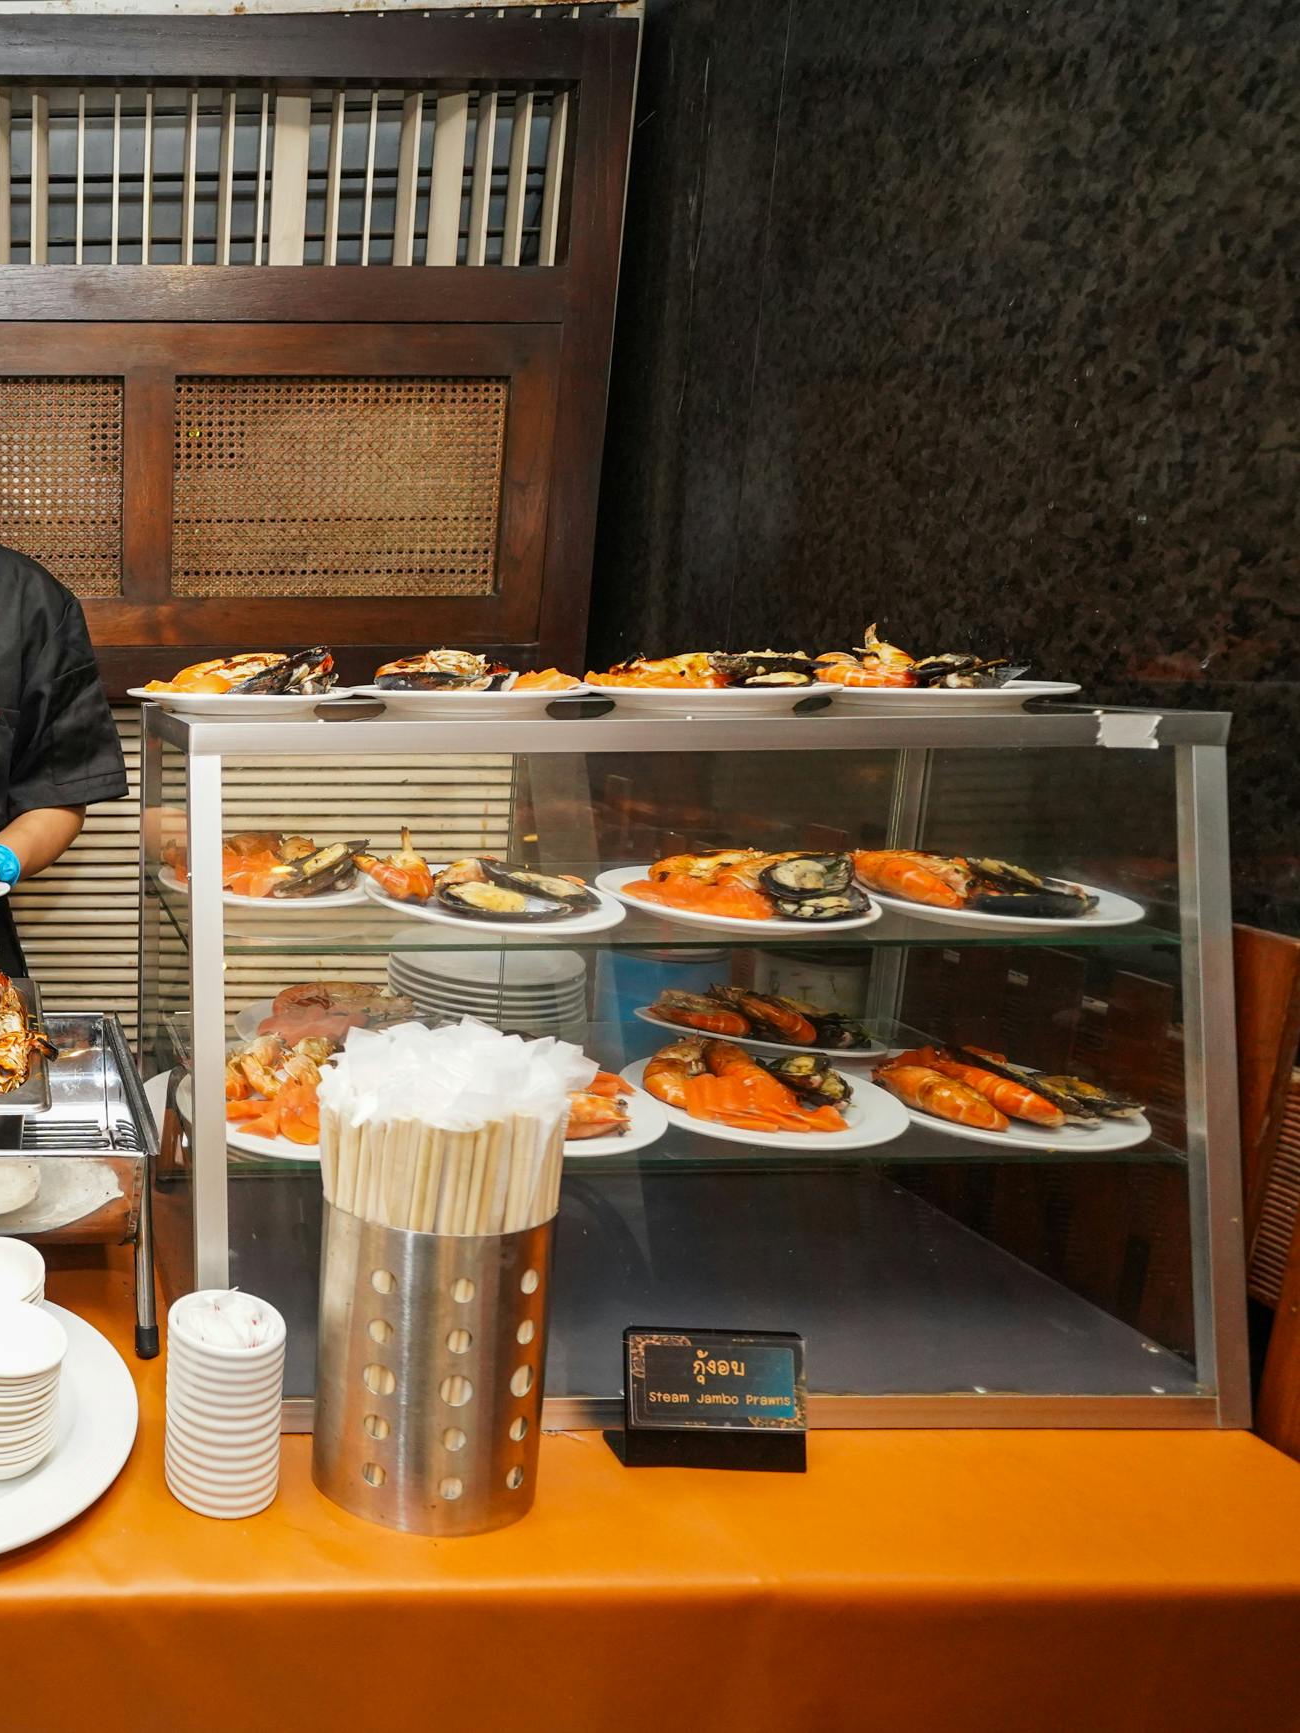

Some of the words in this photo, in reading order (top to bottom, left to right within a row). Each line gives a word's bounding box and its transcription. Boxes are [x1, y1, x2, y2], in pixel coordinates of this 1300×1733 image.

[693, 1349, 746, 1386] กุ้งอบ
[649, 1391, 690, 1403] Steam
[696, 1393, 740, 1406] Jambo
[746, 1394, 791, 1406] Prawns
